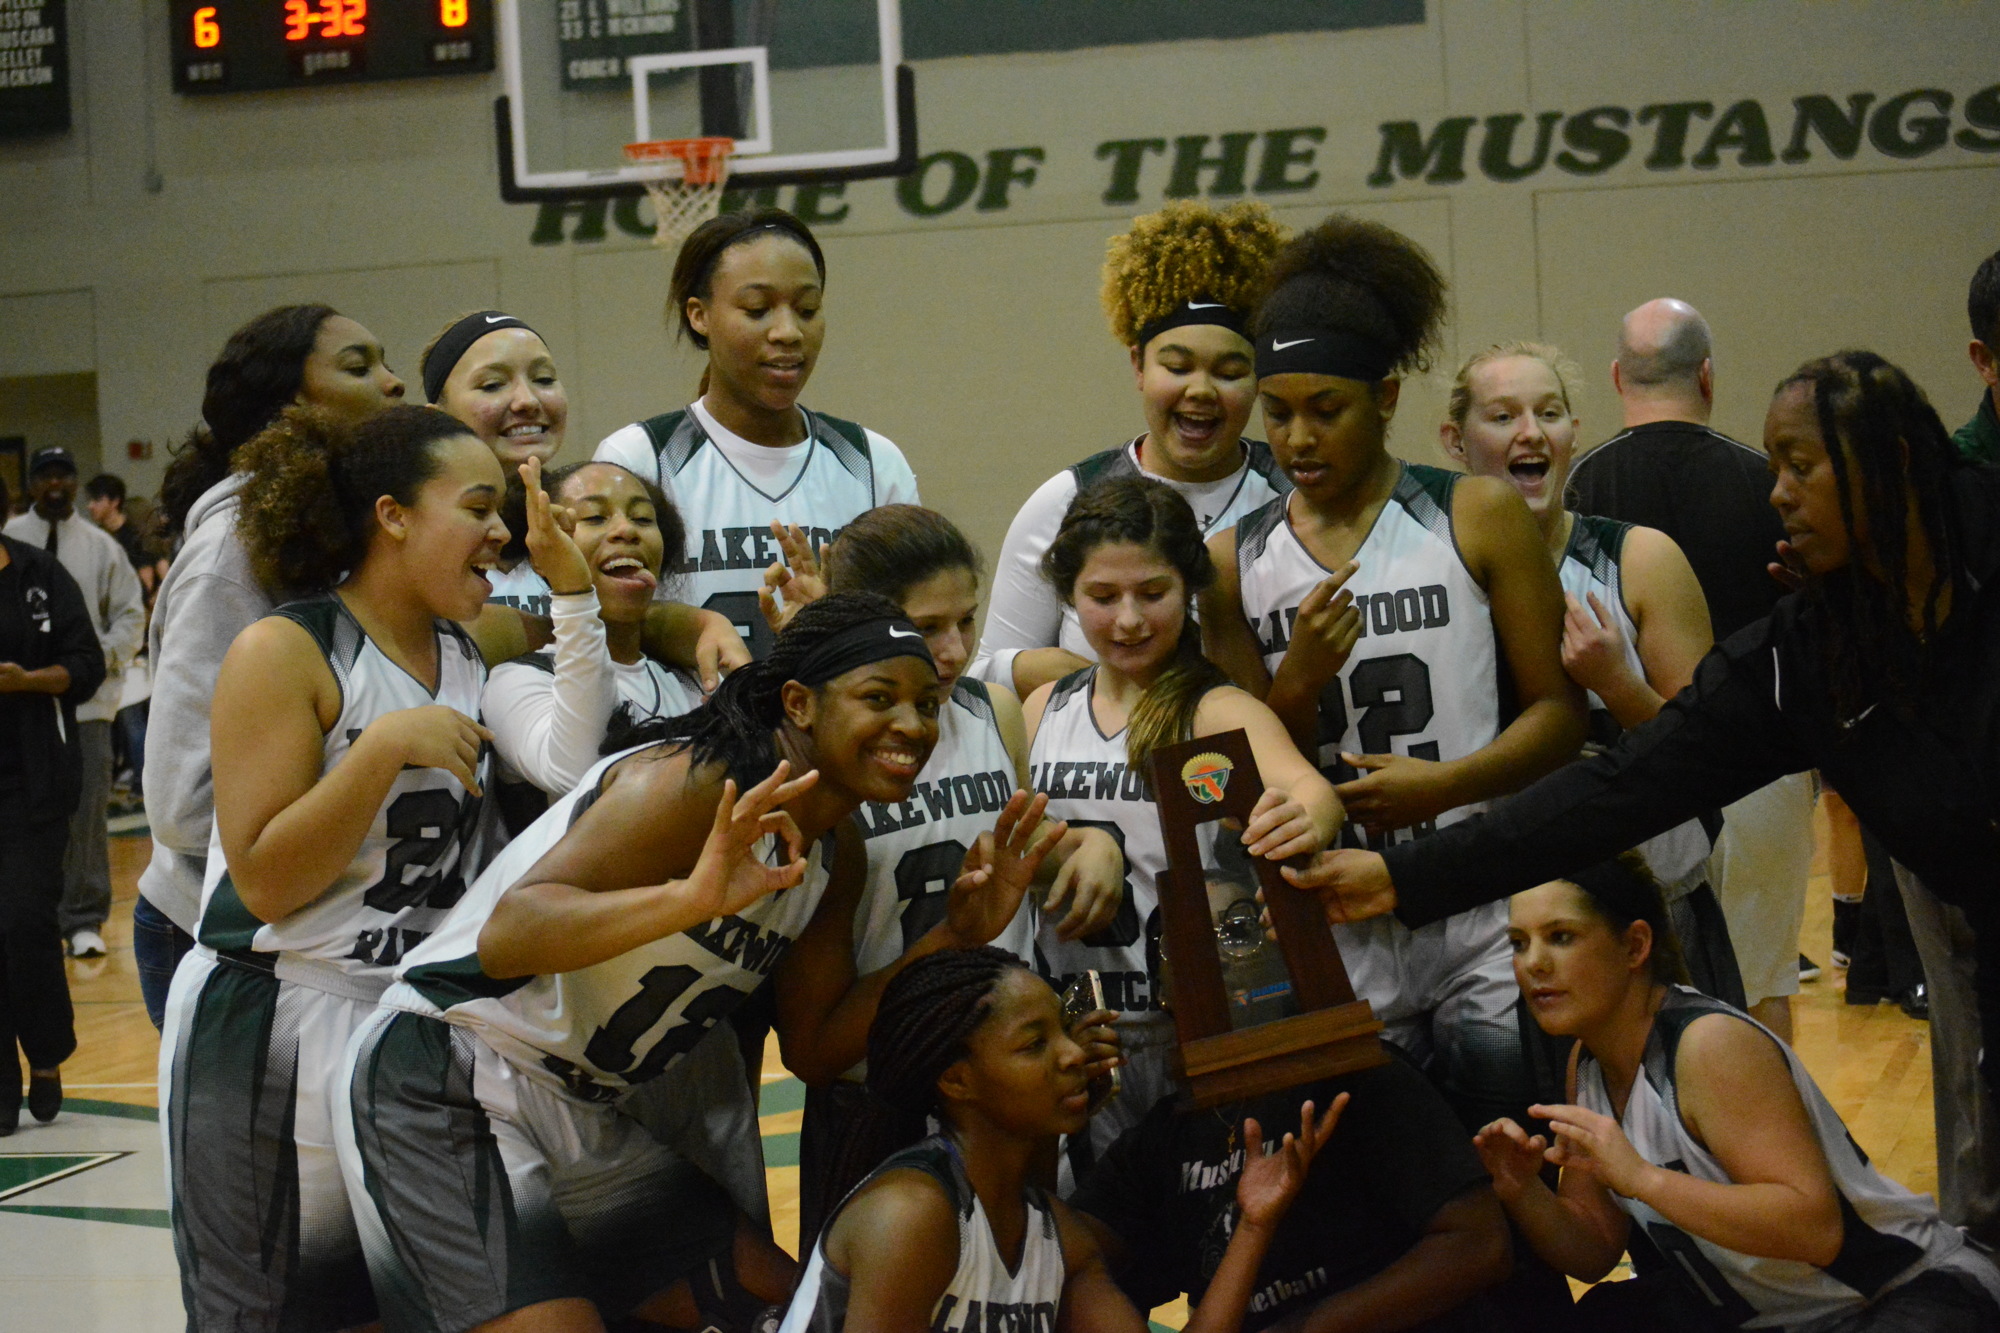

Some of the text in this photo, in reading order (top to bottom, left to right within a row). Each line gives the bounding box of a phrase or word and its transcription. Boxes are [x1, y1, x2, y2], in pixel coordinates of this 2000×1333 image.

[193, 6, 221, 49] 6
[440, 0, 468, 28] 8
[897, 146, 1046, 218] OF
[1096, 126, 1326, 206] THE
[1366, 84, 2000, 188] MUSTANGS
